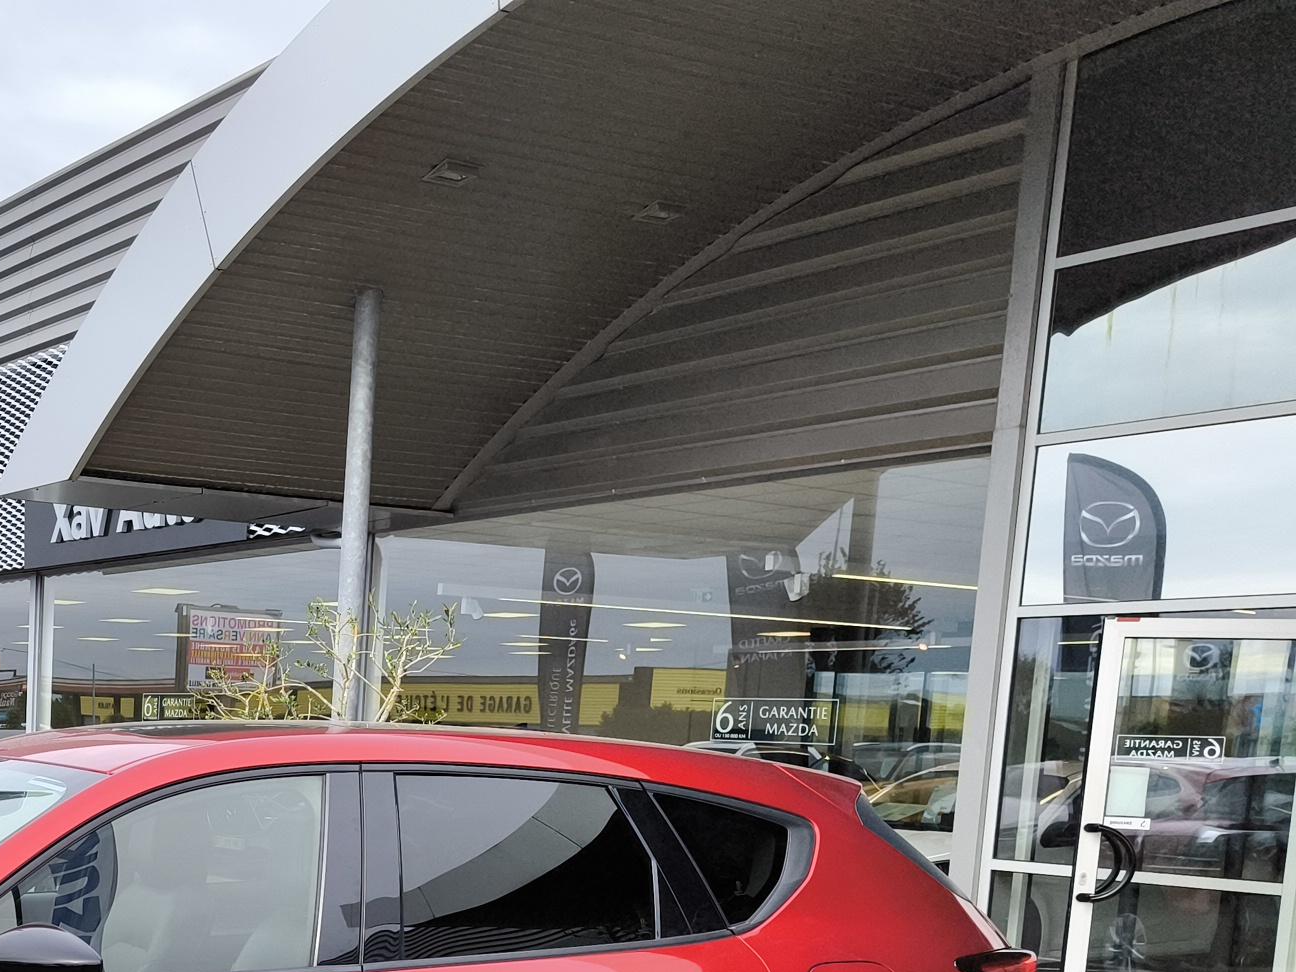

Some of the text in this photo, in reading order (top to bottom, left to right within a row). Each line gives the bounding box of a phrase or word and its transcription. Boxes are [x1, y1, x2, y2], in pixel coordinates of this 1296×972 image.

[144, 695, 152, 717] 6
[164, 709, 188, 718] MAZDA
[716, 701, 828, 733] 6 ANS GARANTIE
[765, 723, 819, 736] MAZDA
